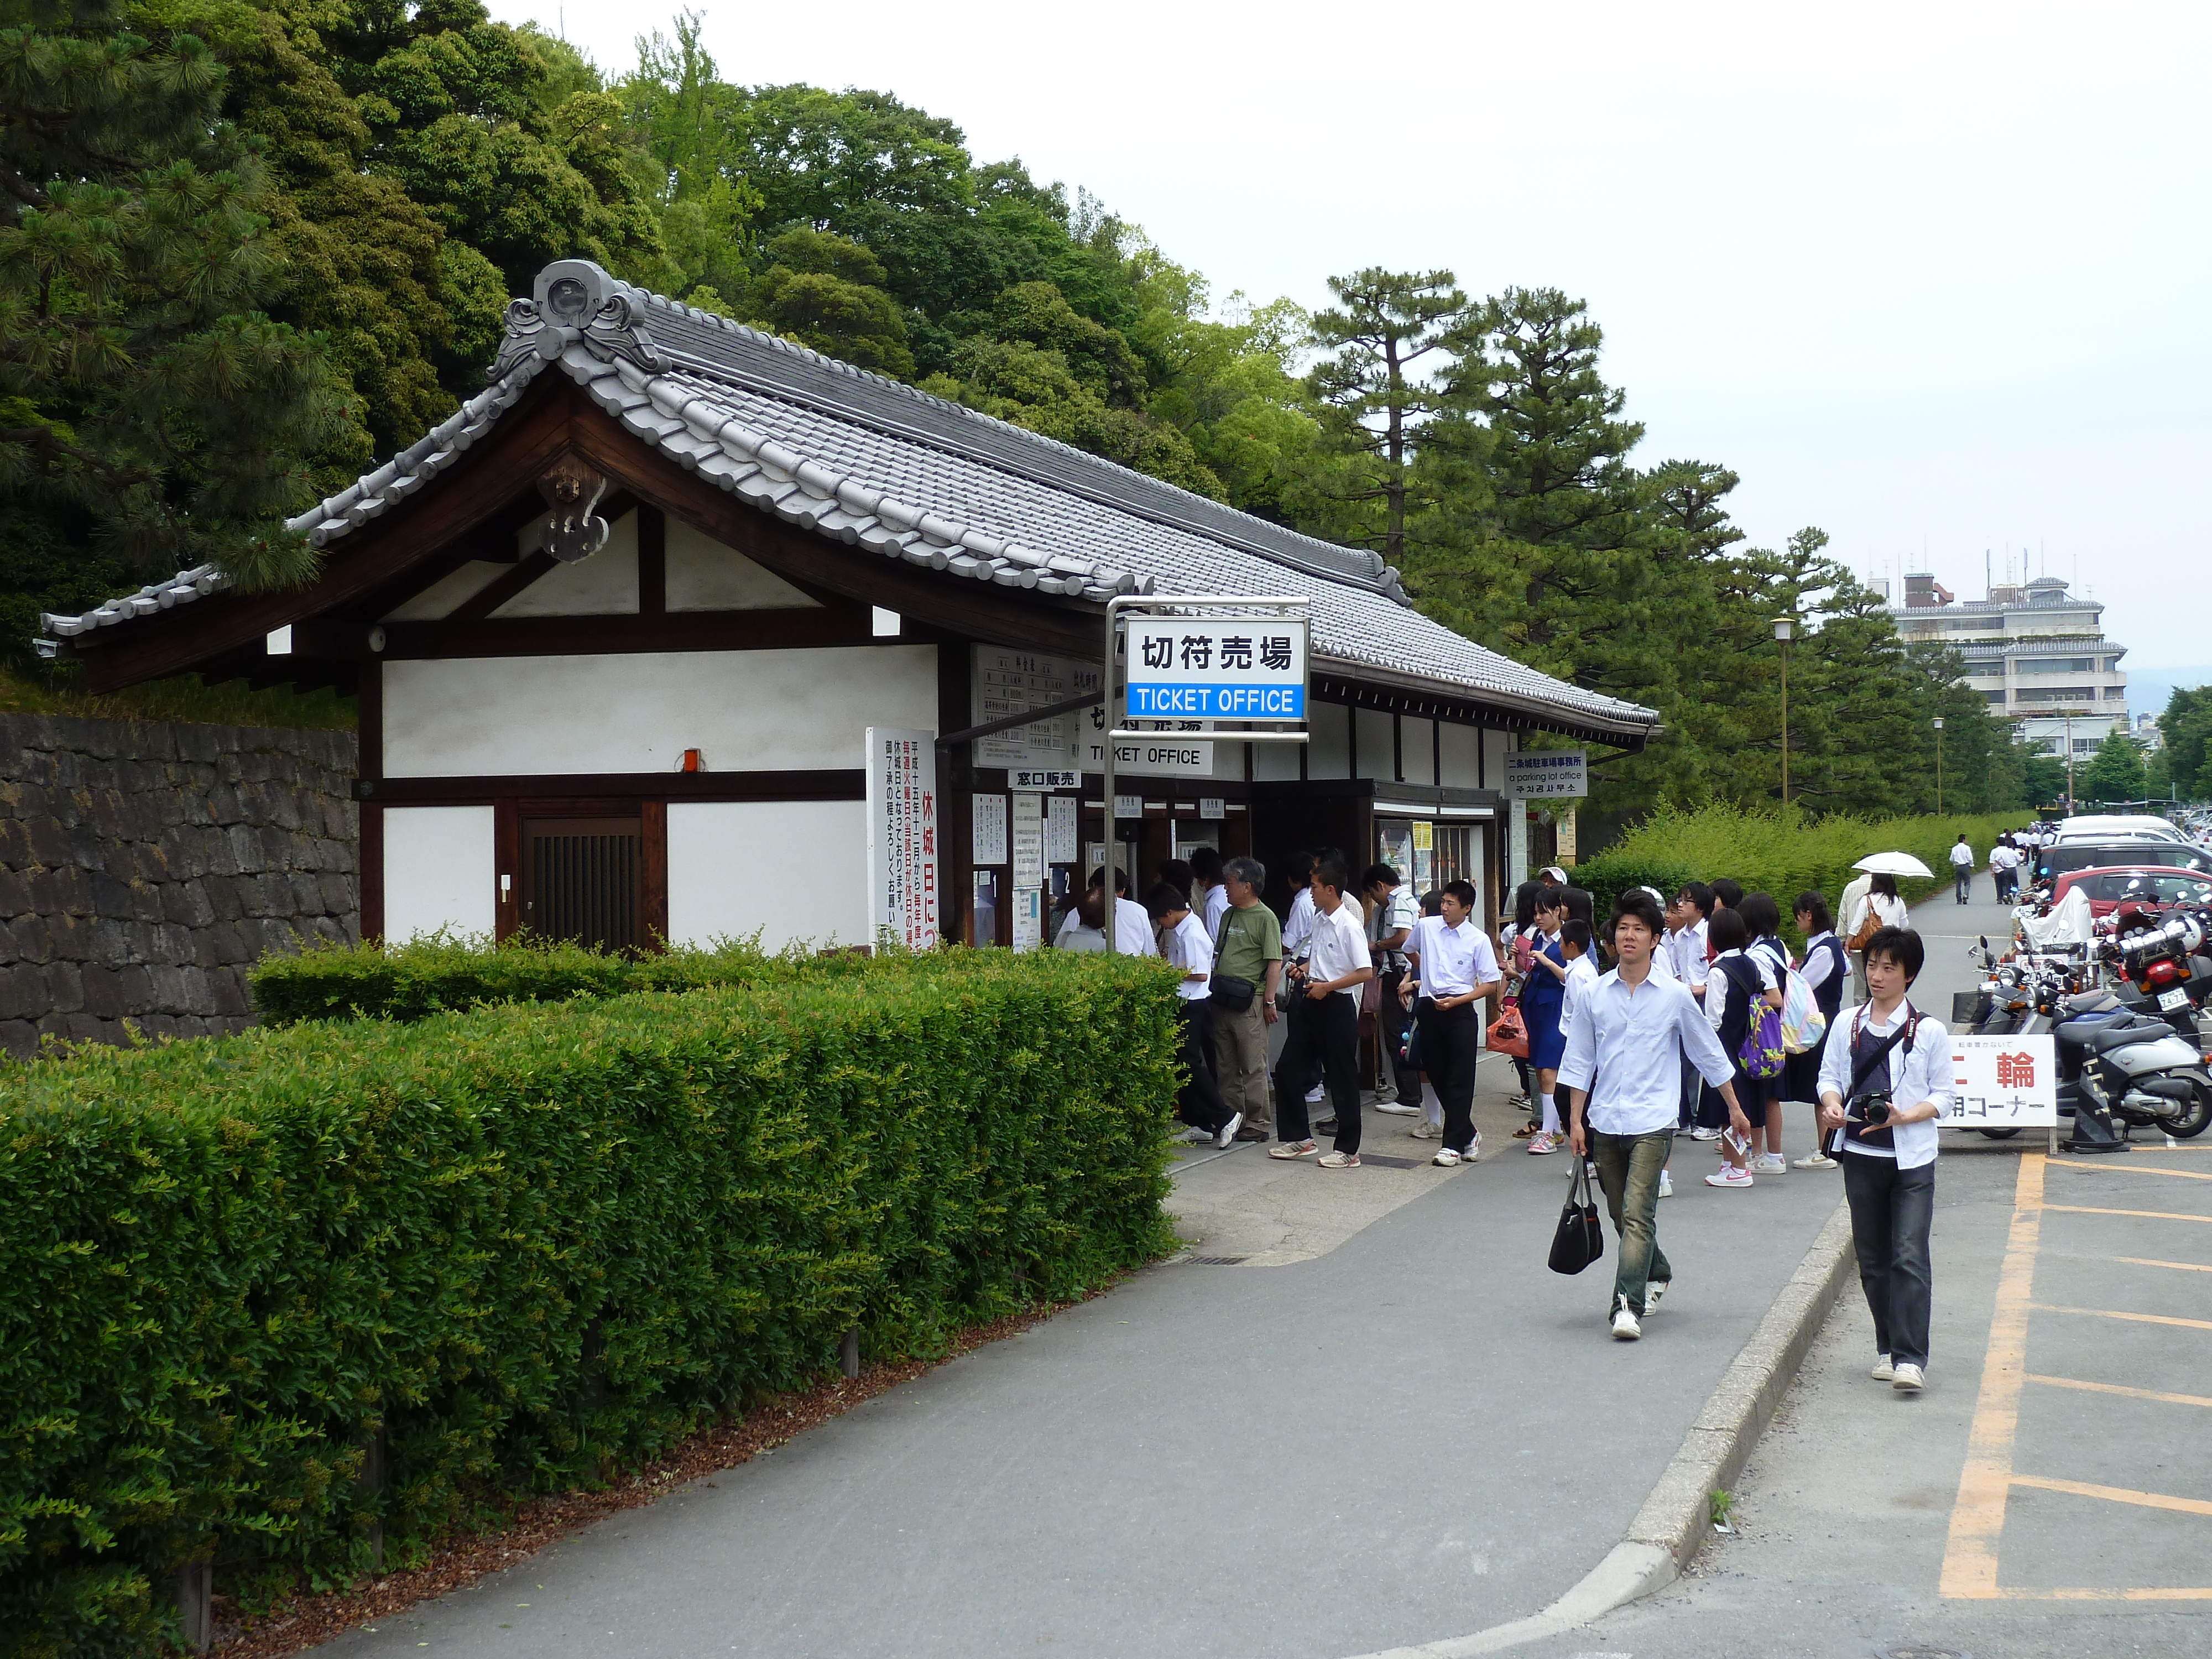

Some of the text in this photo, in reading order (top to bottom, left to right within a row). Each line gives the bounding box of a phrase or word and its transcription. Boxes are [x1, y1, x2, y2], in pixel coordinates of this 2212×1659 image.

[1141, 635, 1292, 670] 切符売場
[1137, 688, 1293, 712] TICKET OFFICE
[1090, 745, 1140, 762] TIKET
[1147, 748, 1201, 765] OFFICE
[1508, 756, 1582, 769] 二条城駐車場事務所
[1017, 771, 1074, 786] 窓口販売
[1517, 773, 1546, 782] parking
[1548, 771, 1558, 780] lot
[1559, 771, 1582, 780] office
[993, 874, 997, 898] 1
[1065, 872, 1070, 894] 2
[1907, 1018, 1916, 1037] Canon
